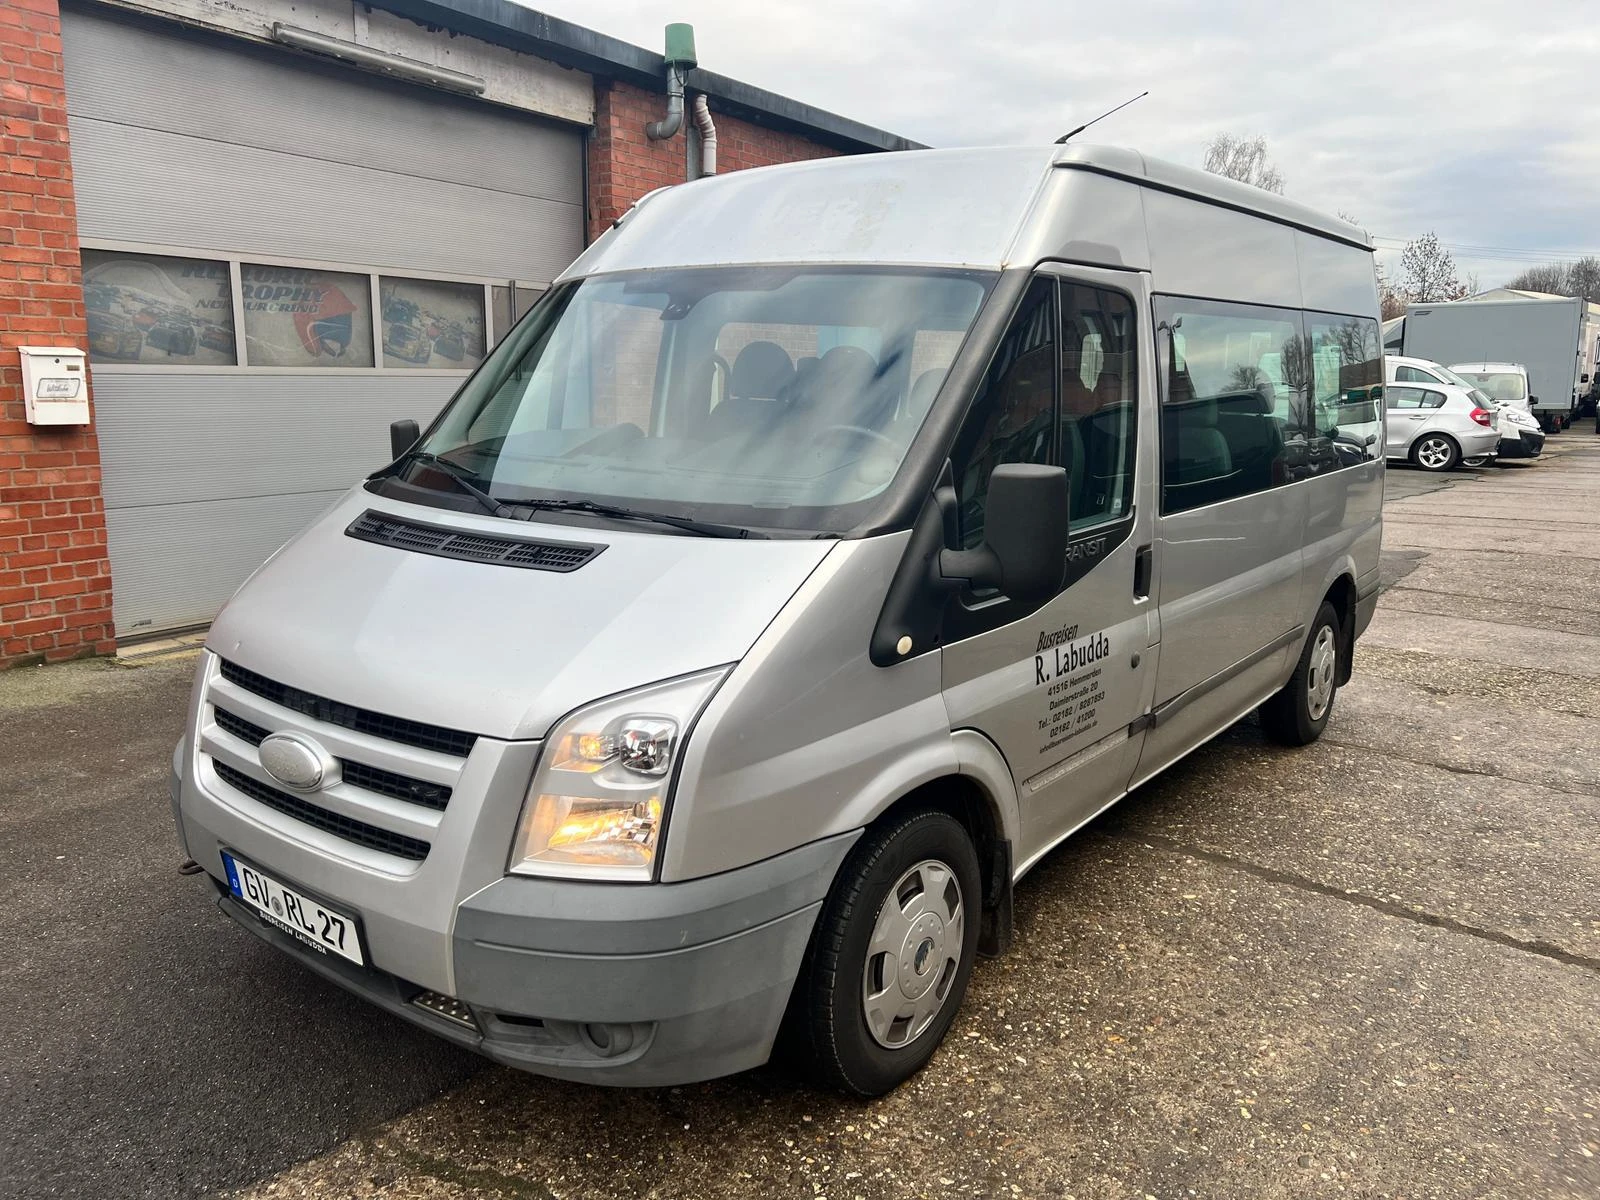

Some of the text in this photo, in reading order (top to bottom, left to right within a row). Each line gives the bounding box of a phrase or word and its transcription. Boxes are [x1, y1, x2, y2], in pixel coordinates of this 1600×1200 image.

[1065, 538, 1107, 561] RANSIT
[1036, 624, 1079, 652] Busreisen
[1035, 632, 1110, 686] R. Labudda
[1047, 667, 1102, 697] 41516 Hemmerden
[1049, 681, 1099, 711] Daimlerstraße 20
[1038, 718, 1051, 730] Tel.:
[1052, 706, 1073, 723] 02182
[1049, 721, 1071, 738] 02182
[242, 867, 270, 909] GV
[282, 889, 317, 935] RL
[317, 908, 345, 951] 27
[295, 931, 327, 955] LABUDDA
